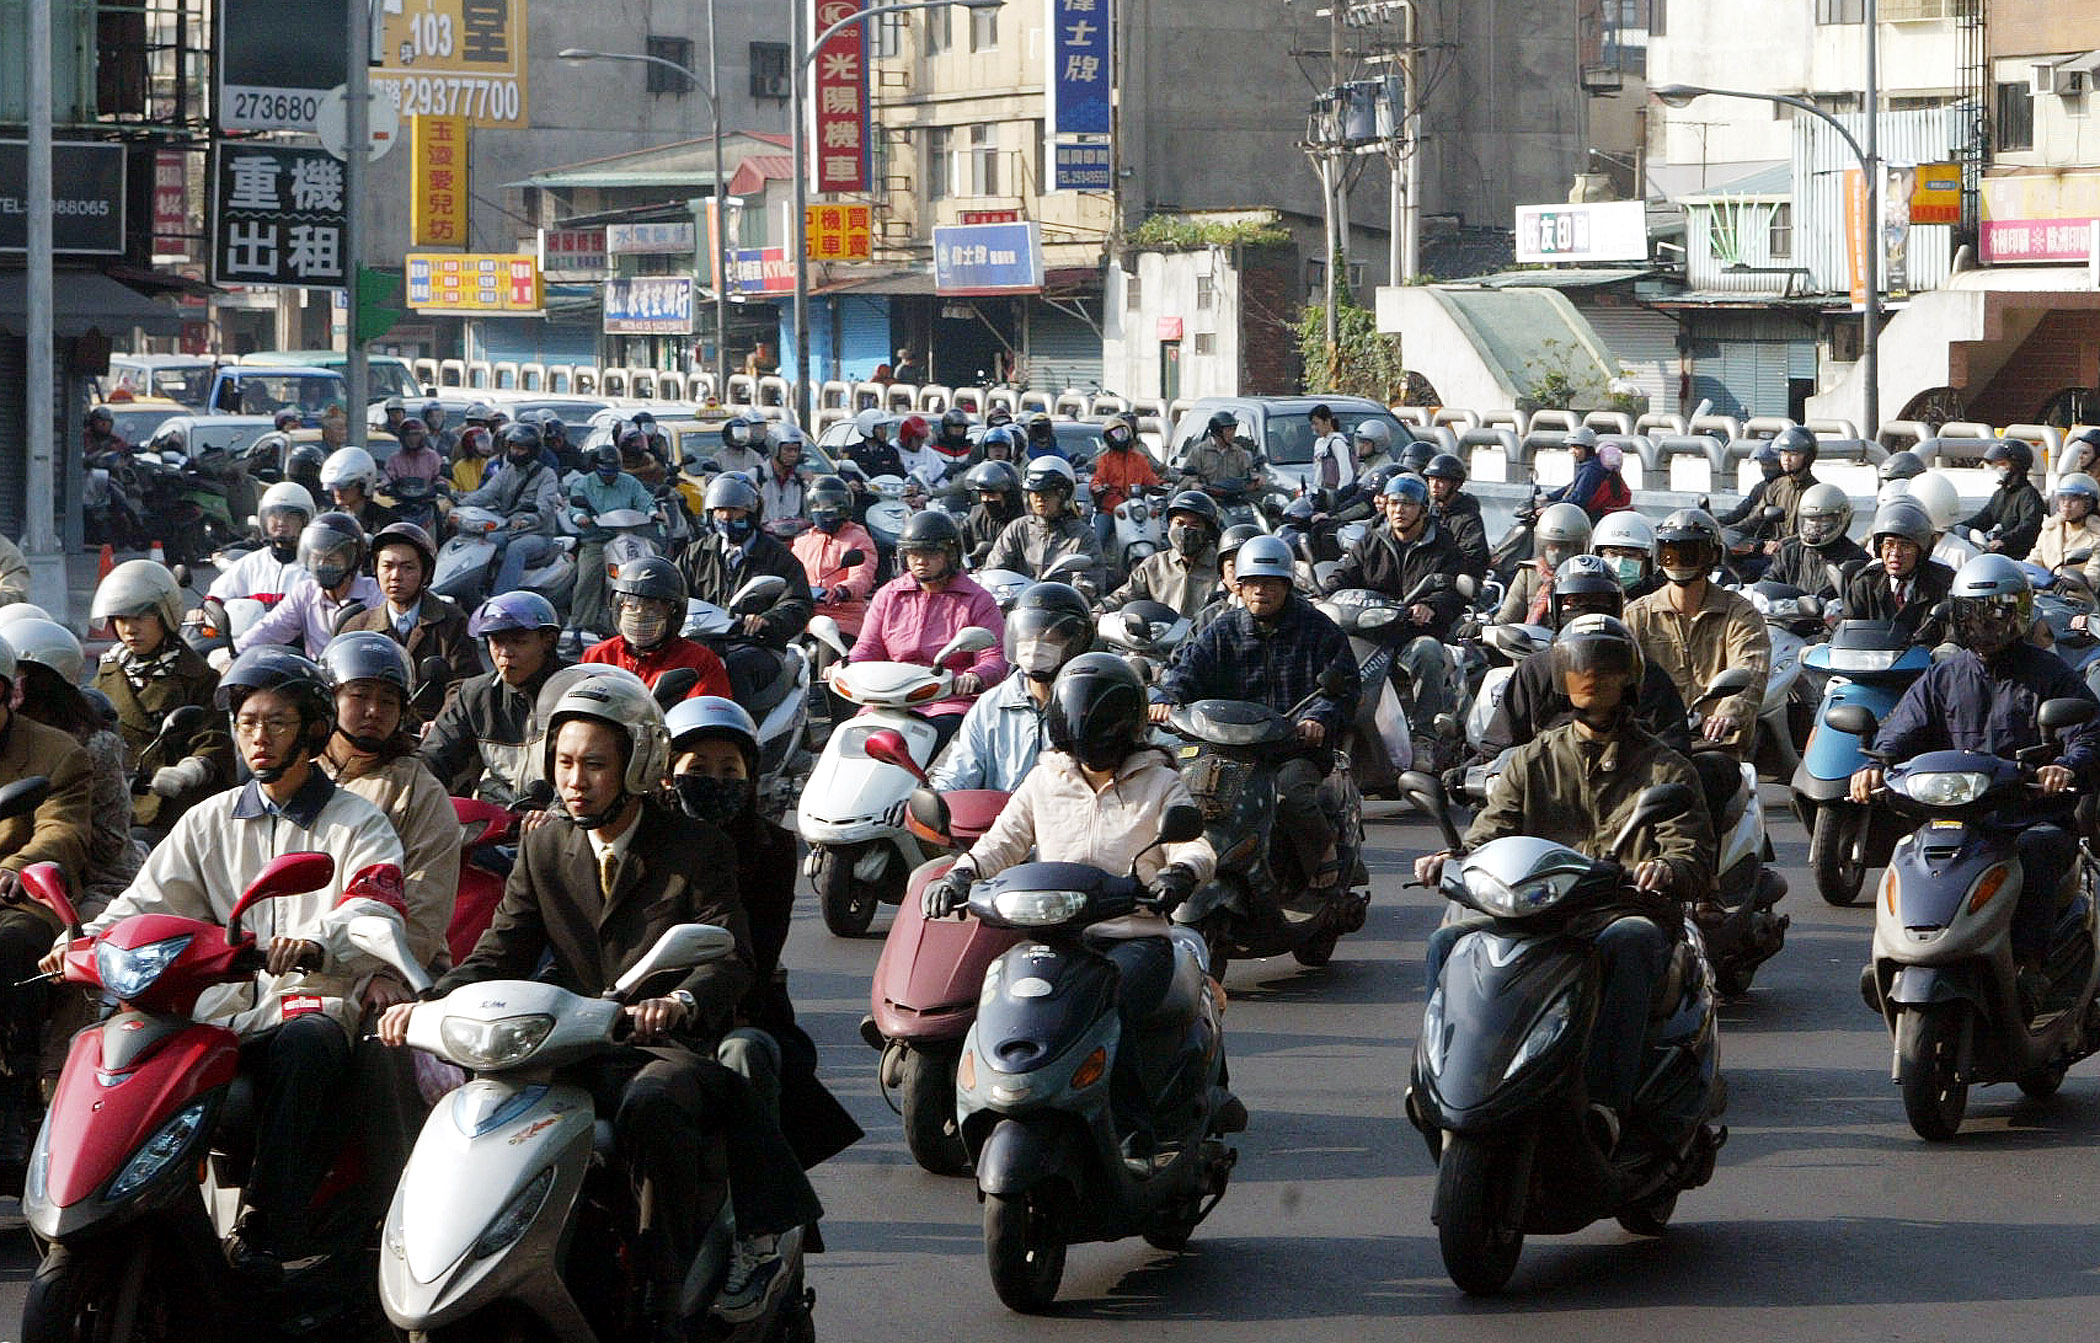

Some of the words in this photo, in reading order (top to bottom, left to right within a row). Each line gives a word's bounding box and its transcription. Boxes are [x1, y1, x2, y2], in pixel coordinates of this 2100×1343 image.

[410, 13, 452, 56] 103
[235, 93, 323, 122] 273680
[403, 77, 519, 120] 29377700
[822, 53, 859, 181] 光陽機車
[228, 156, 344, 212] 重機
[227, 221, 343, 278] 出租
[821, 209, 841, 255] 機車
[848, 208, 868, 256] 買賣
